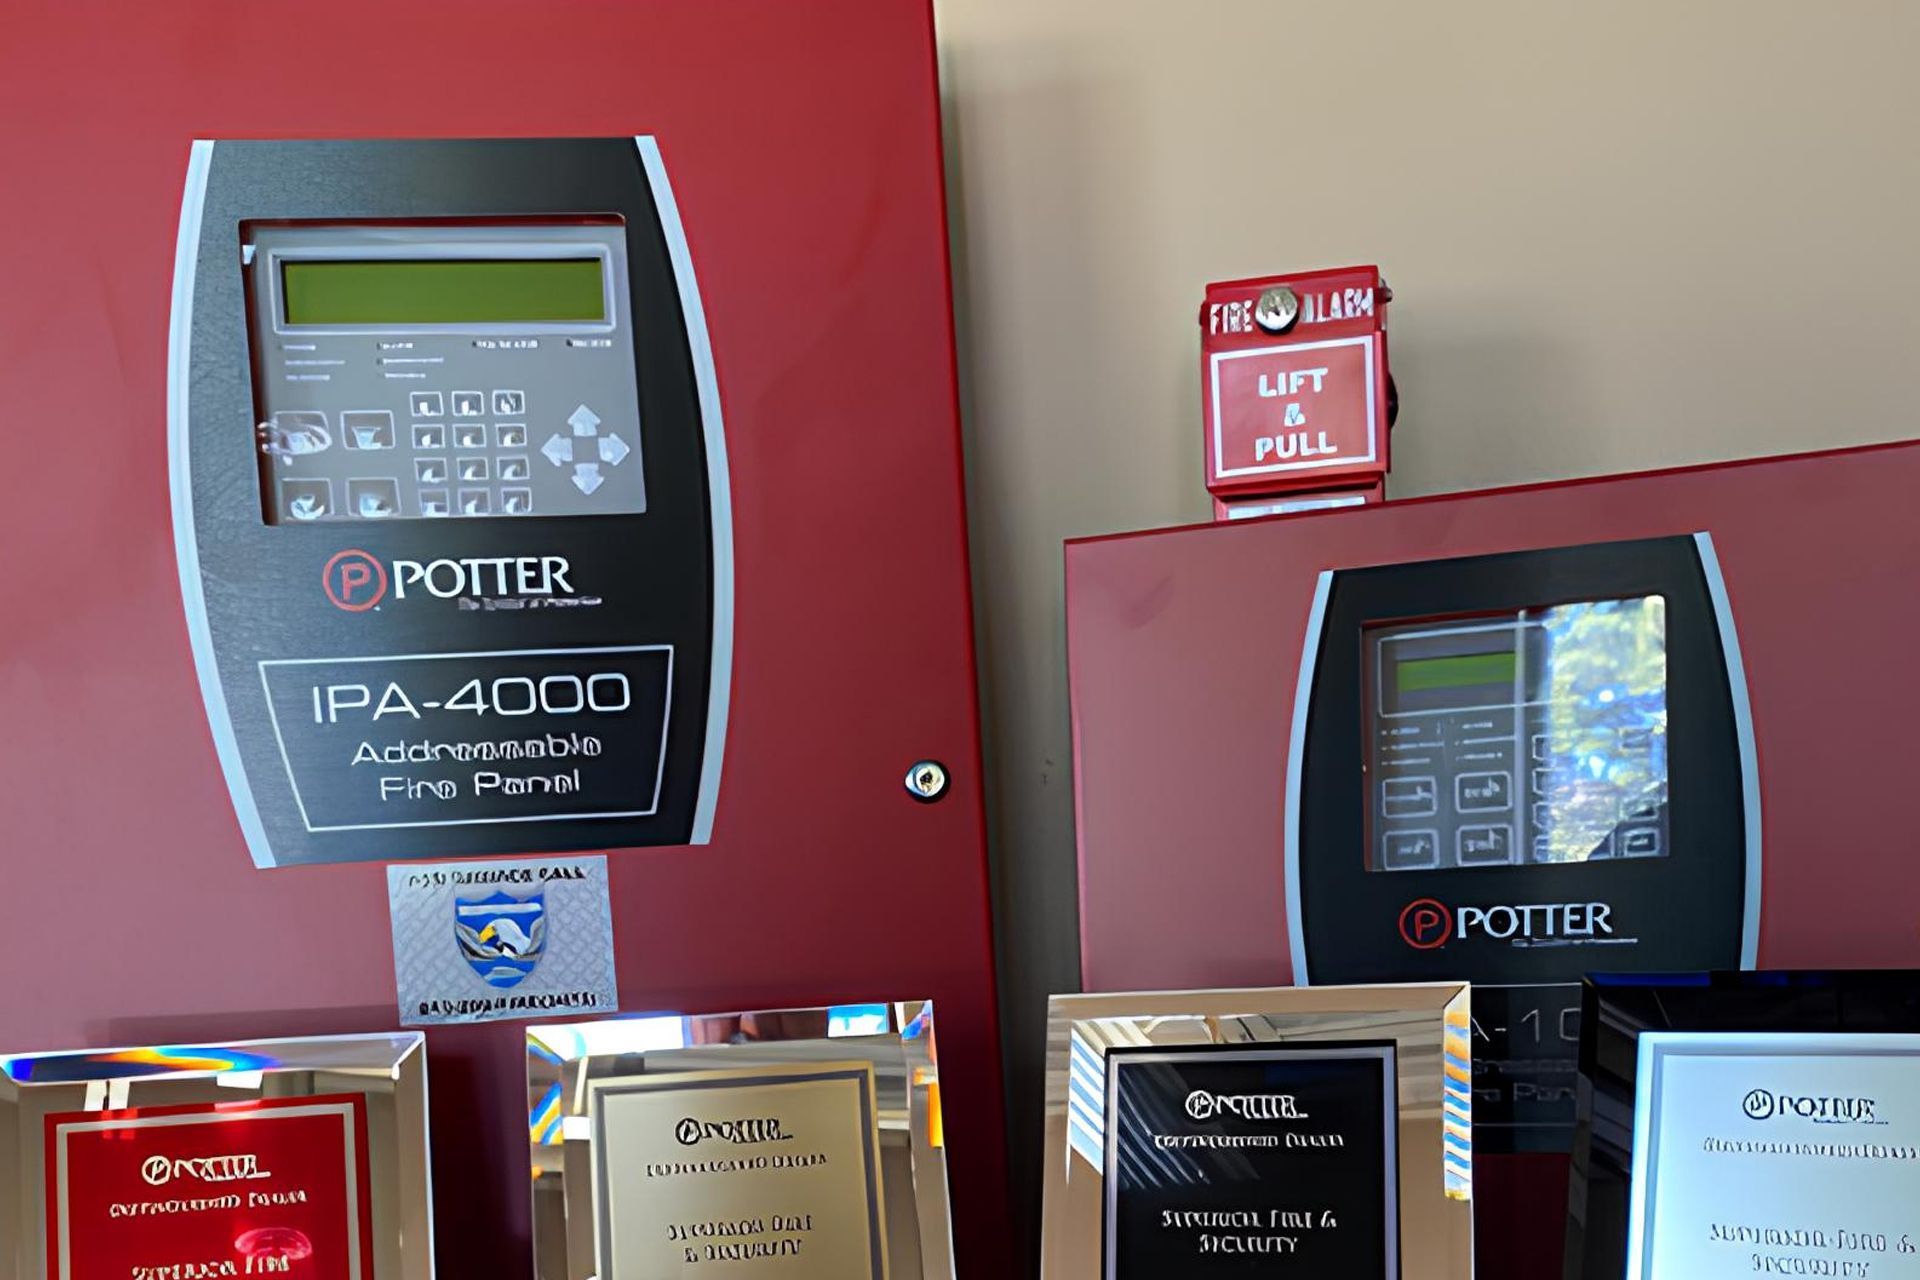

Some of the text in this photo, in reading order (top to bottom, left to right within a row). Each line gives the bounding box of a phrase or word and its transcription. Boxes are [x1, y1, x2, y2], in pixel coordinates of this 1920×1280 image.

[1259, 367, 1328, 397] LIFT
[1255, 432, 1338, 461] PULL
[393, 556, 575, 599] POTTER
[313, 672, 631, 724] IPA-4000
[1457, 902, 1614, 939] POTTER
